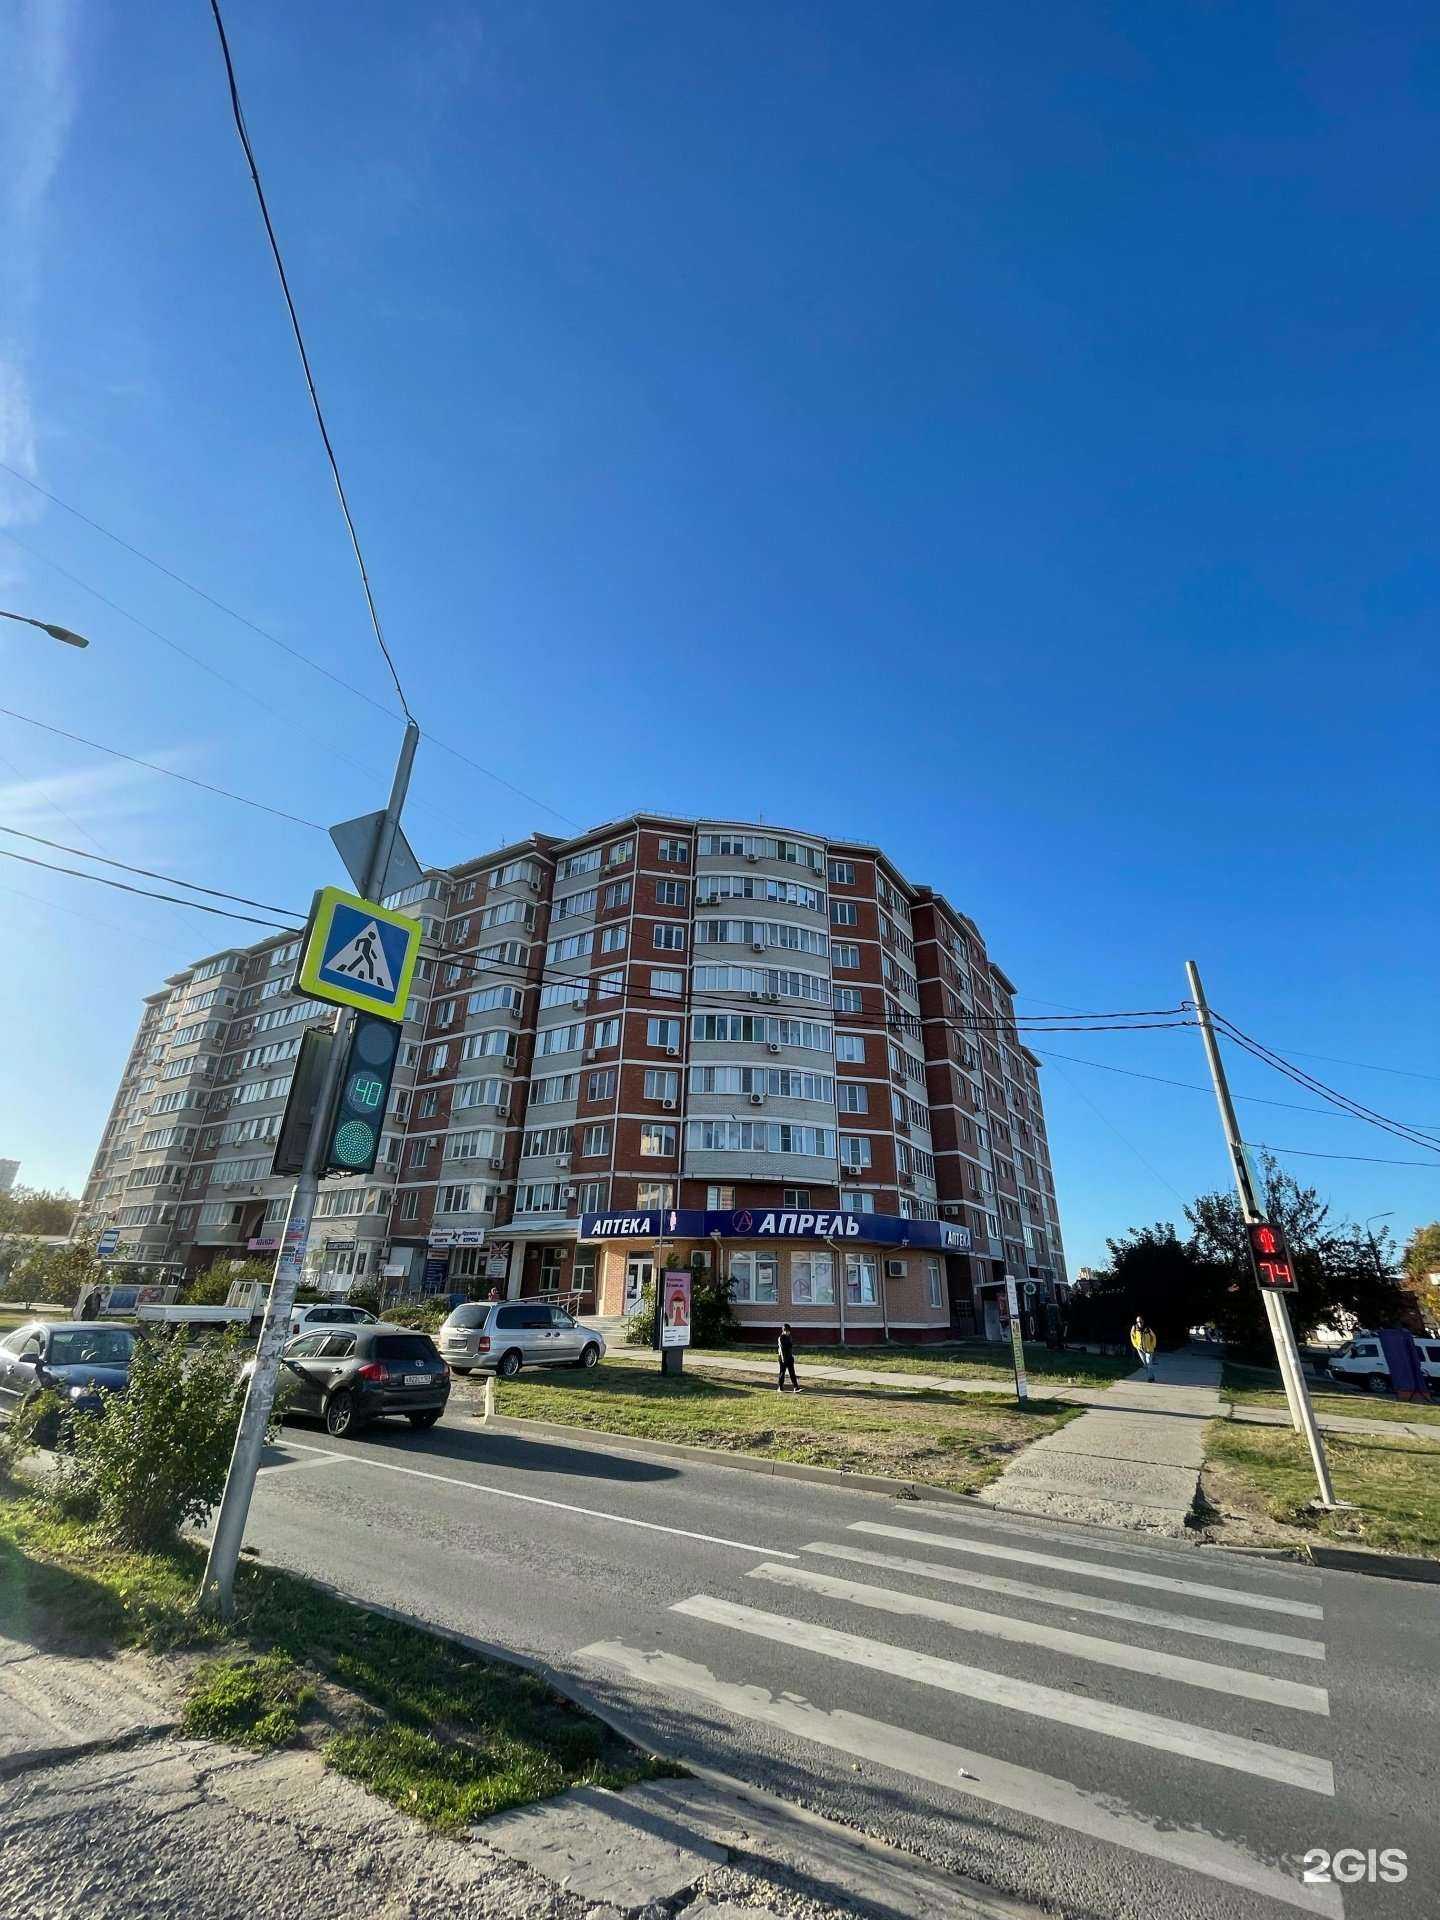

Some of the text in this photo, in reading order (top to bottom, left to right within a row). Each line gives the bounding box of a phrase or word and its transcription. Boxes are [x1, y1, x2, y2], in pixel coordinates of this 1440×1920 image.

[356, 1079, 382, 1106] 40
[591, 1217, 650, 1235] АПТЕКА
[758, 1213, 860, 1236] АПРЕЛЬ
[947, 1231, 971, 1249] АПТЕКА
[1259, 1263, 1291, 1283] 74
